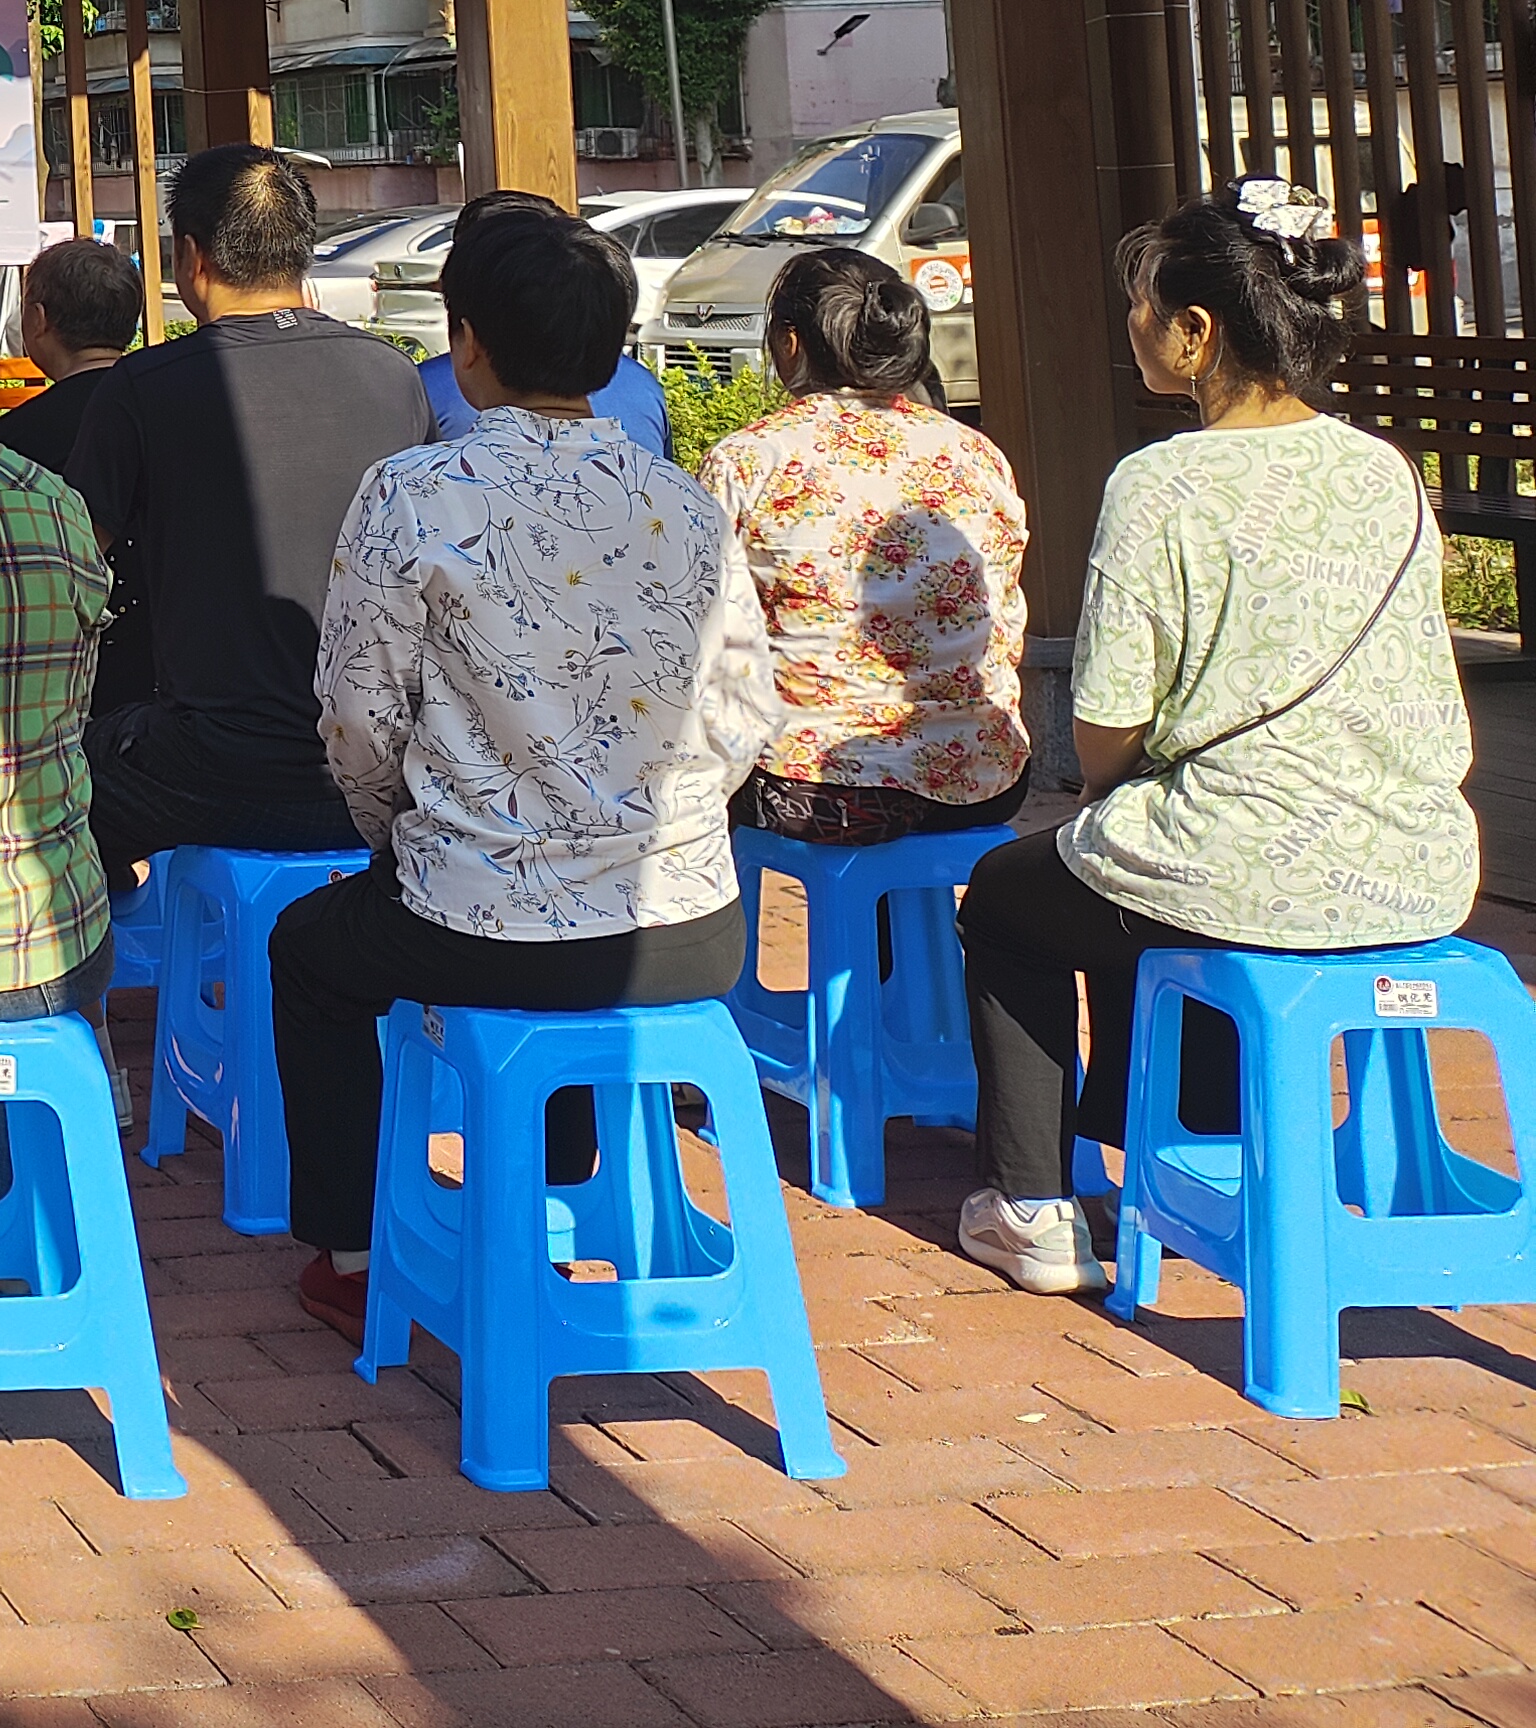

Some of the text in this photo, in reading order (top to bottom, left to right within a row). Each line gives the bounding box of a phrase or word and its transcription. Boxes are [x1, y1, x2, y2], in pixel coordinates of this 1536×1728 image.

[1231, 463, 1295, 565] SIKHAND
[1290, 552, 1390, 594] SIKHAND
[1324, 869, 1436, 916] SIKHAND
